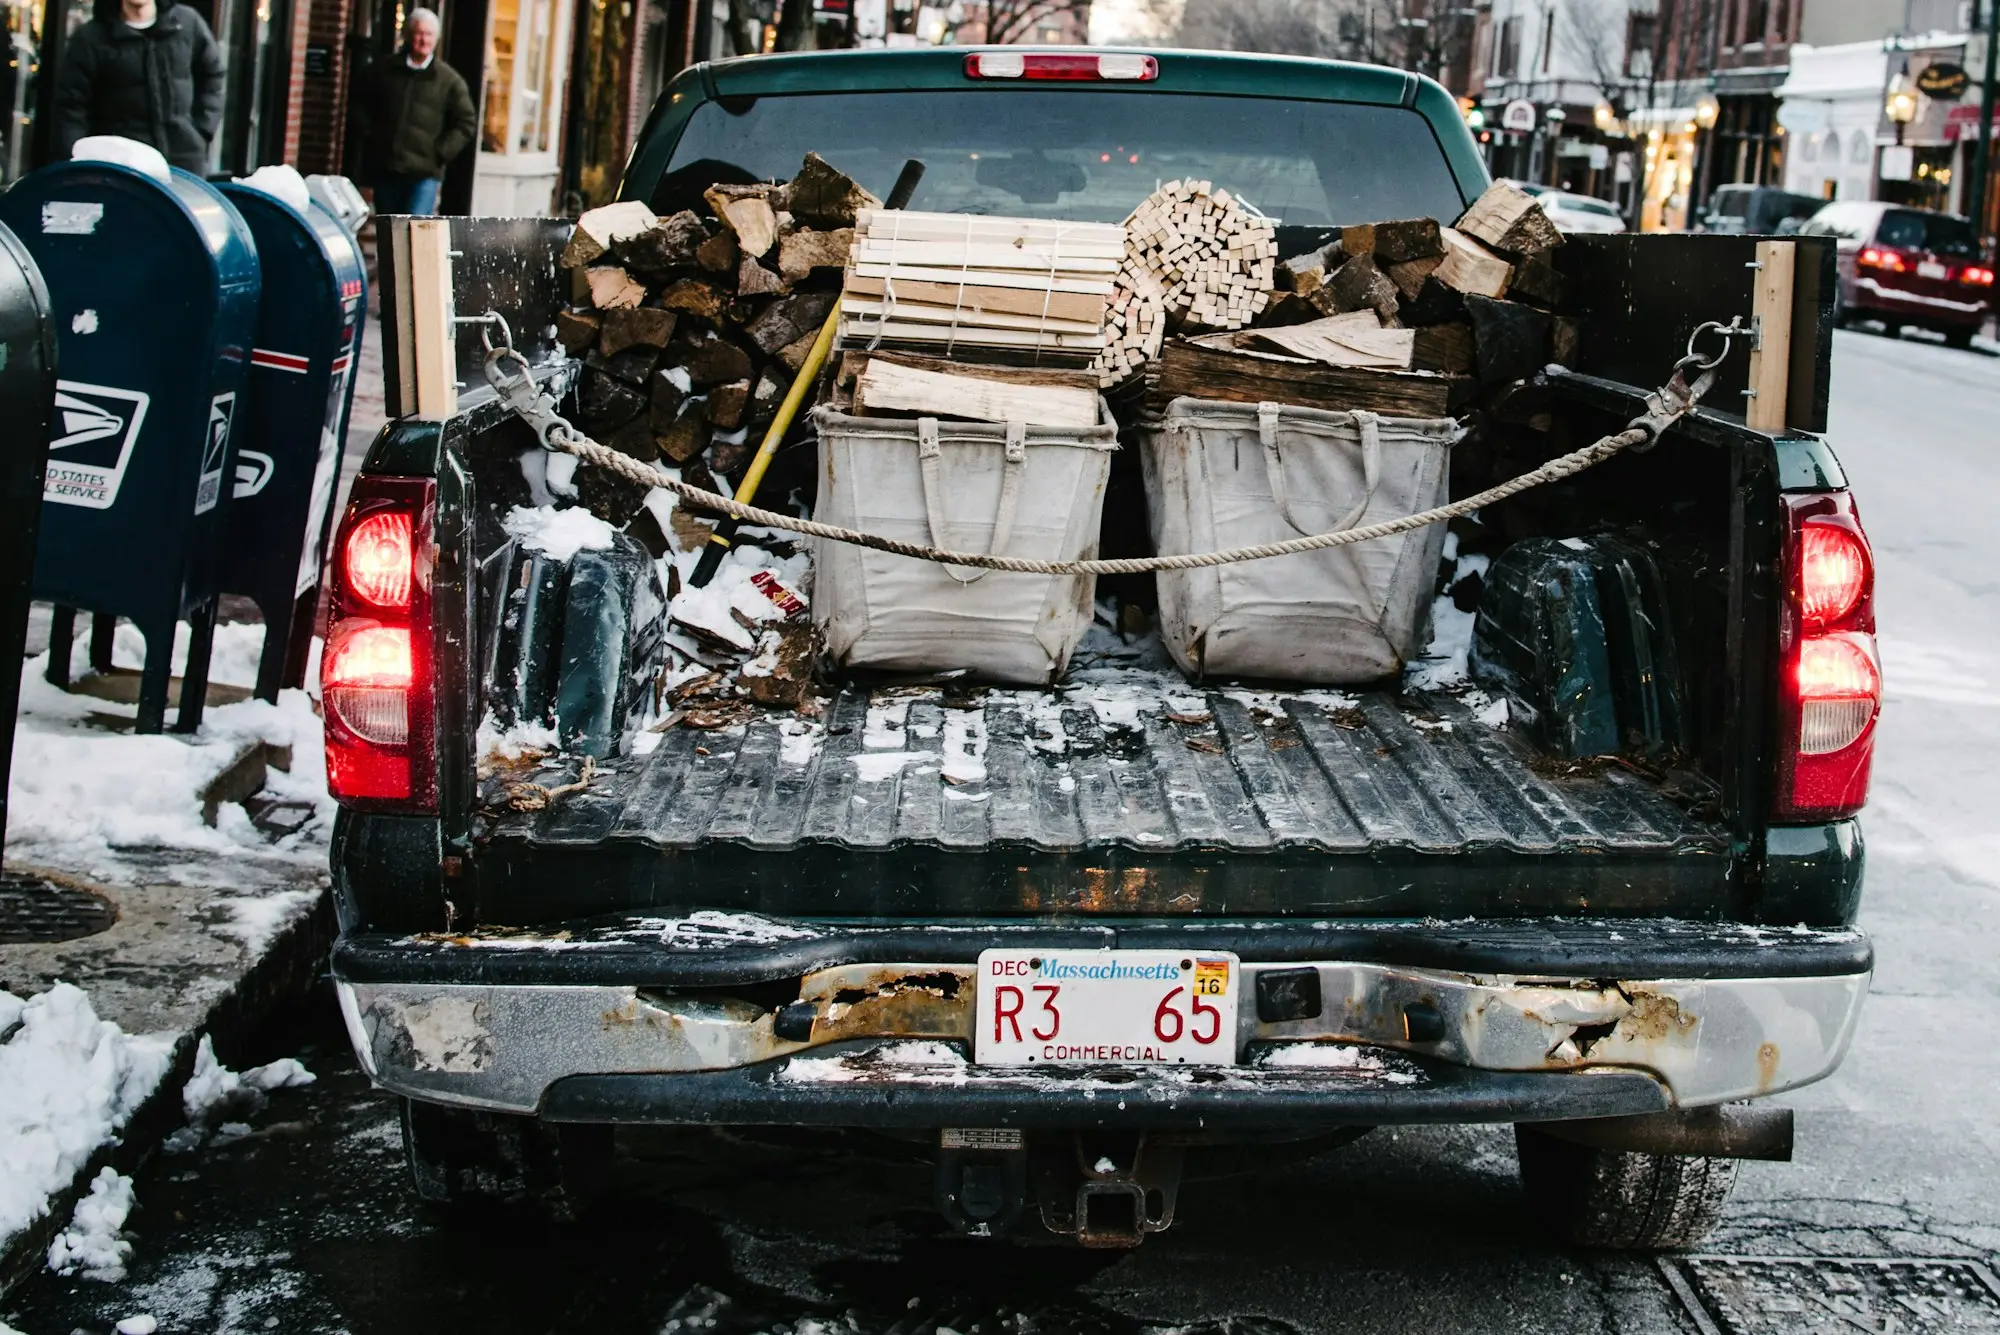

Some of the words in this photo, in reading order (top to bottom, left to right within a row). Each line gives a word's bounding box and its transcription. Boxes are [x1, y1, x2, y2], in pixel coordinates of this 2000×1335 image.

[60, 470, 106, 486] STATES
[55, 484, 108, 500] SERVICE
[992, 961, 1028, 976] DEC
[1037, 959, 1180, 980] Massachusetts
[1198, 978, 1220, 994] 16
[994, 985, 1060, 1043] R3
[1154, 986, 1221, 1044] 65
[1043, 1045, 1168, 1061] COMMERCIAL
